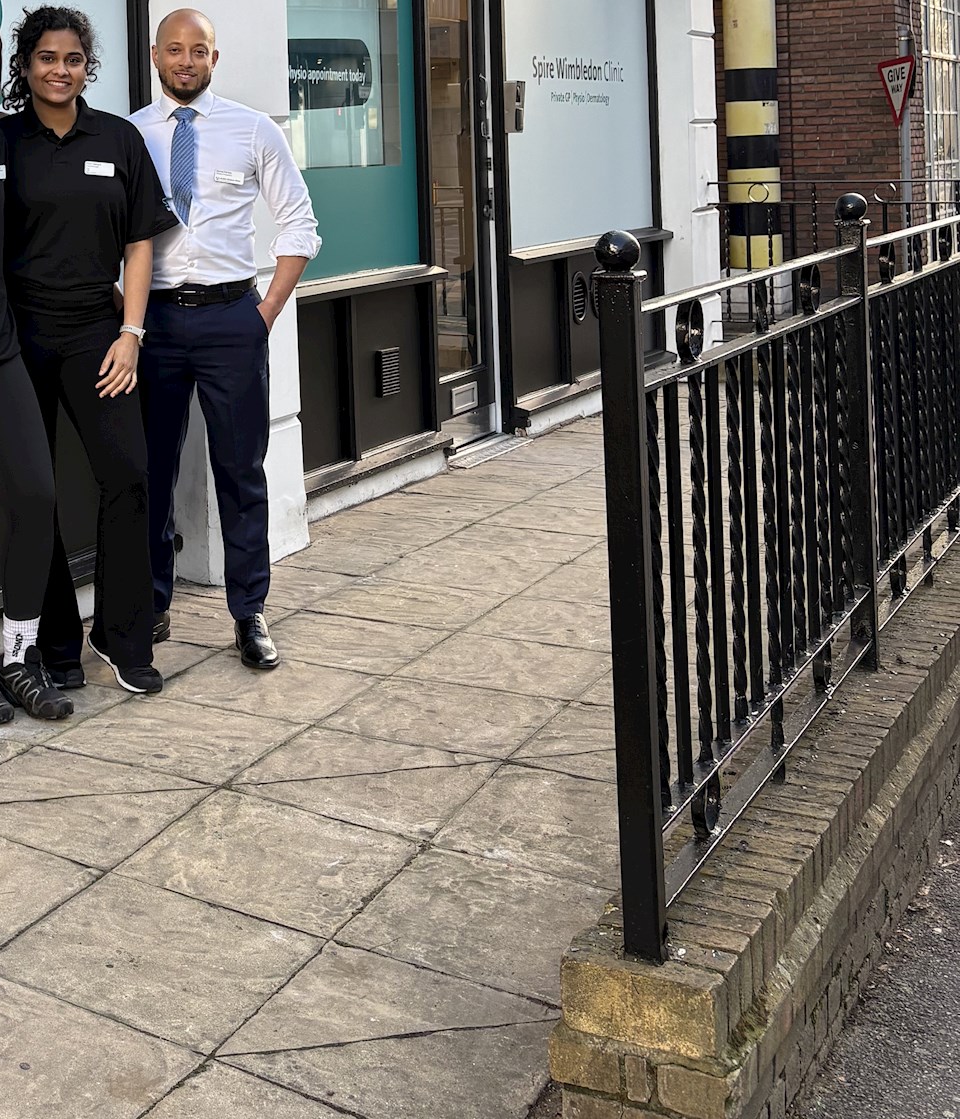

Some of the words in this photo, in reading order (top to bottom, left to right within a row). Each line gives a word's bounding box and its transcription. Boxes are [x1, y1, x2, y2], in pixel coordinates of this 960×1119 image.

[289, 65, 307, 84] hysio
[308, 66, 348, 84] appointment
[349, 68, 366, 86] today
[532, 56, 554, 85] Spire
[555, 57, 602, 81] Wimbledon
[603, 60, 624, 82] Clinic
[887, 67, 906, 83] GIVE
[891, 83, 903, 94] WAY
